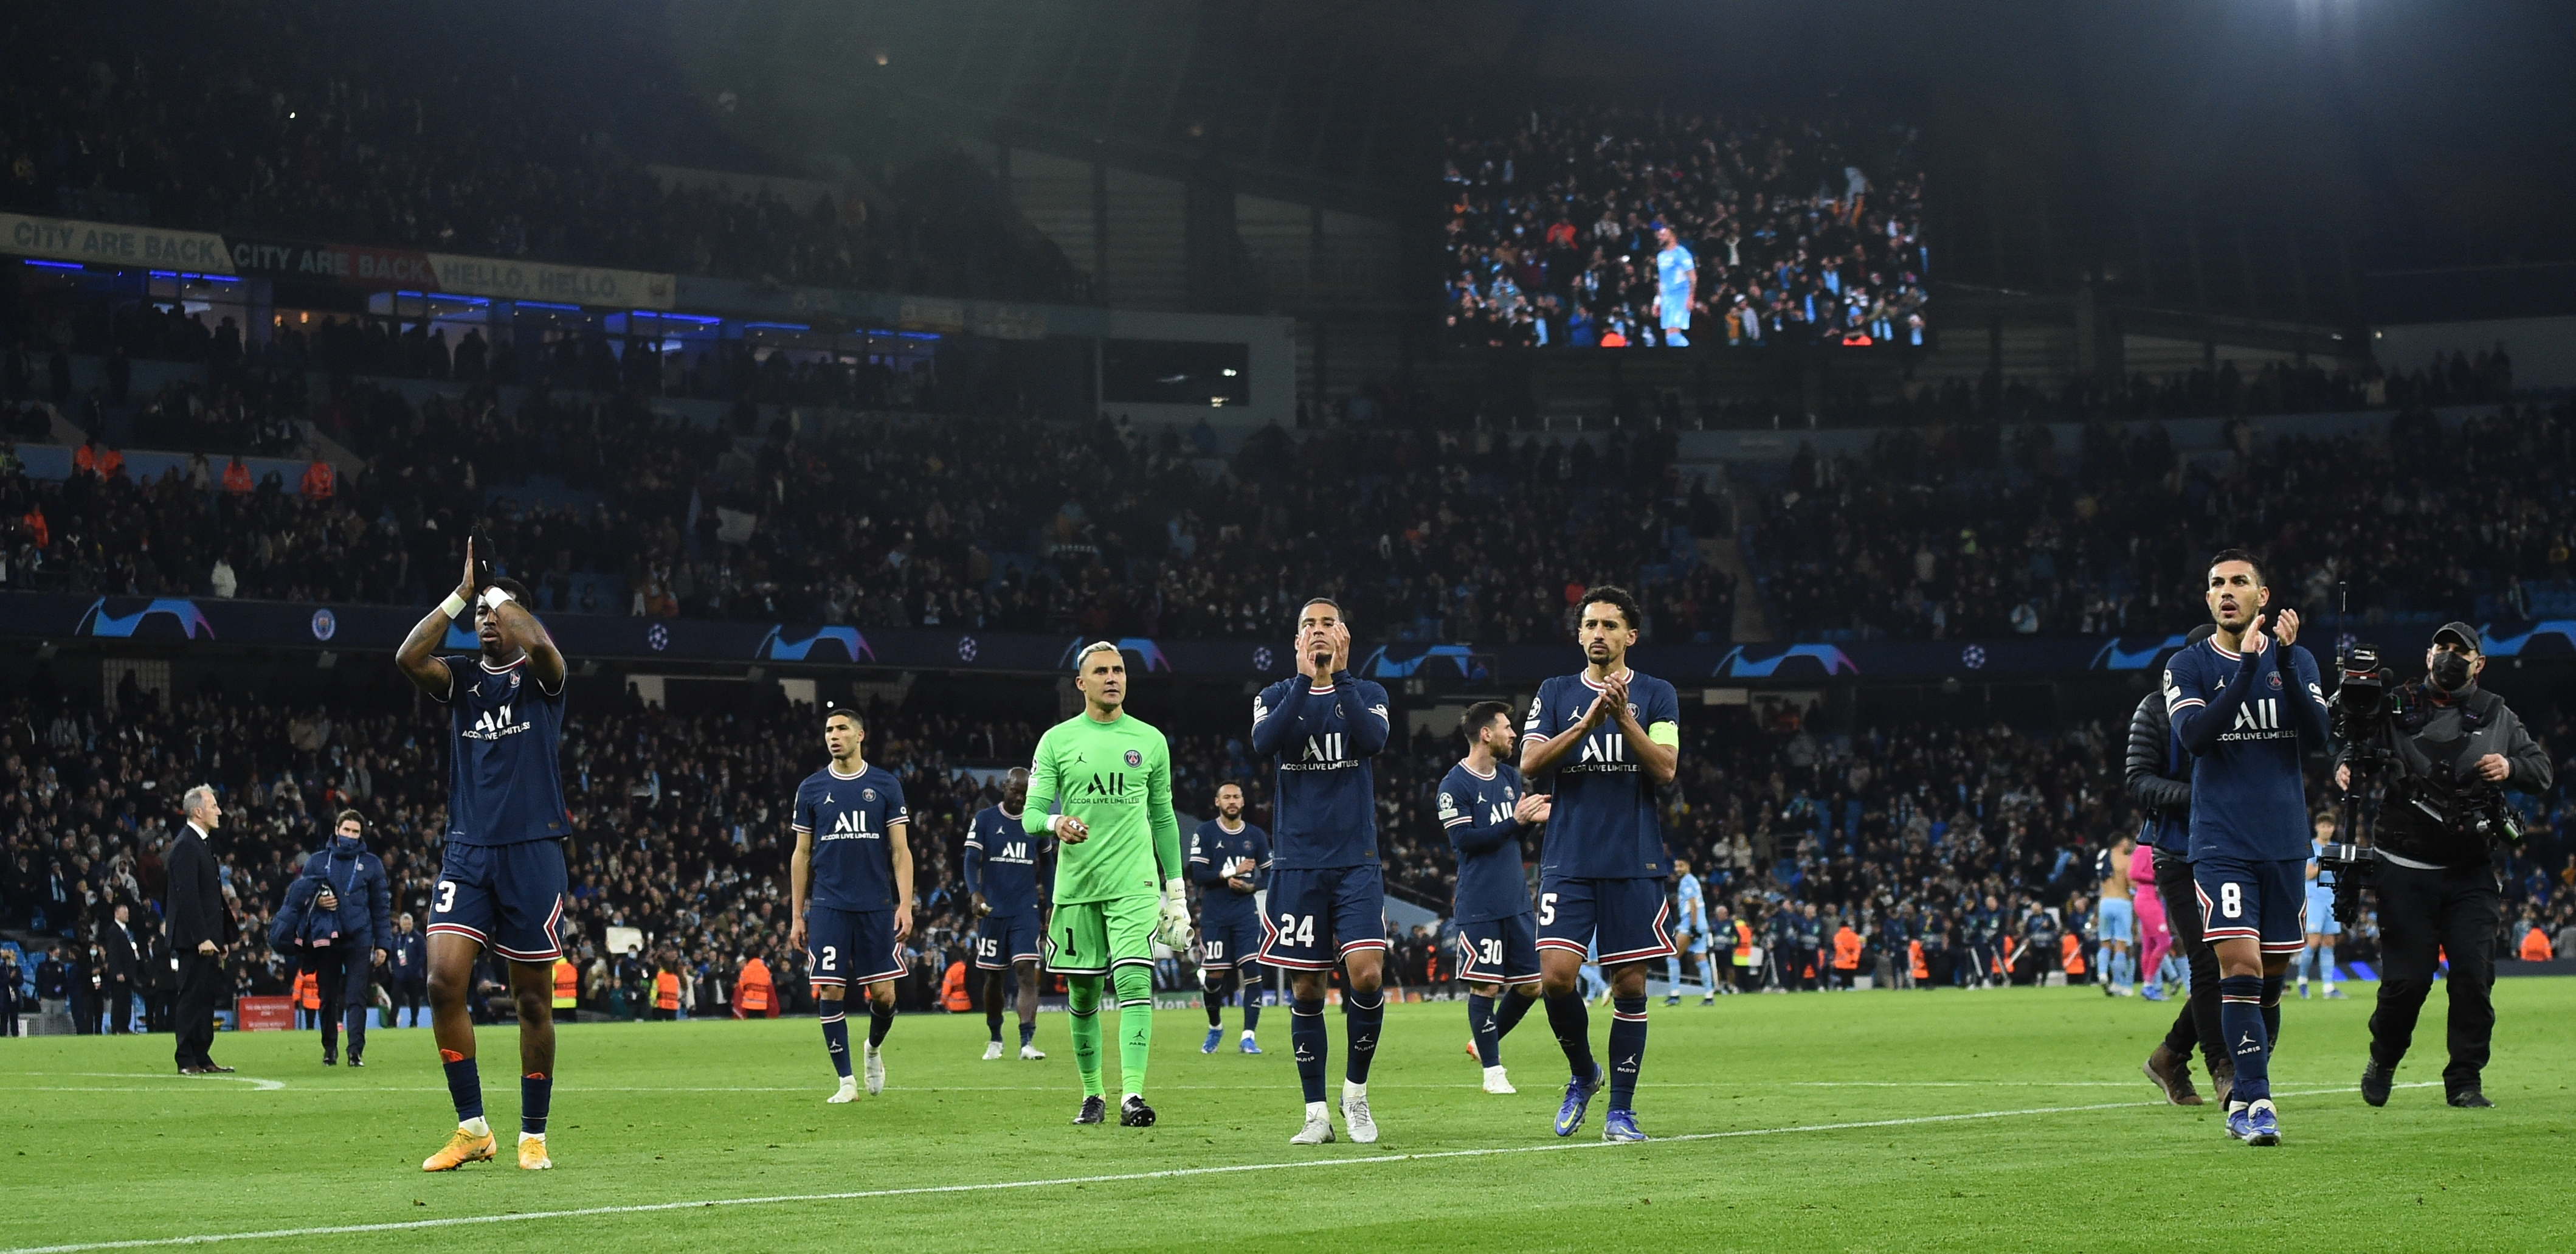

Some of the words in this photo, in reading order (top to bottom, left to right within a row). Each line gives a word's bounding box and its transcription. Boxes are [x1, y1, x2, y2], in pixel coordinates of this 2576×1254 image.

[14, 223, 73, 249] CITY
[83, 230, 136, 257] ARE
[233, 244, 292, 269] CITY
[300, 251, 351, 275] ARE
[2217, 733, 2241, 741] COR
[1562, 764, 1586, 773] ACCOR
[435, 881, 456, 913] 3
[1539, 893, 1558, 926] 5
[2221, 882, 2242, 918] 8
[1065, 927, 1077, 957] 1
[1280, 913, 1314, 947] 24
[822, 946, 836, 971] 2
[979, 937, 997, 957] 15
[1206, 941, 1223, 959] 10
[1479, 938, 1502, 965] 30
[2237, 1045, 2260, 1055] PARIS
